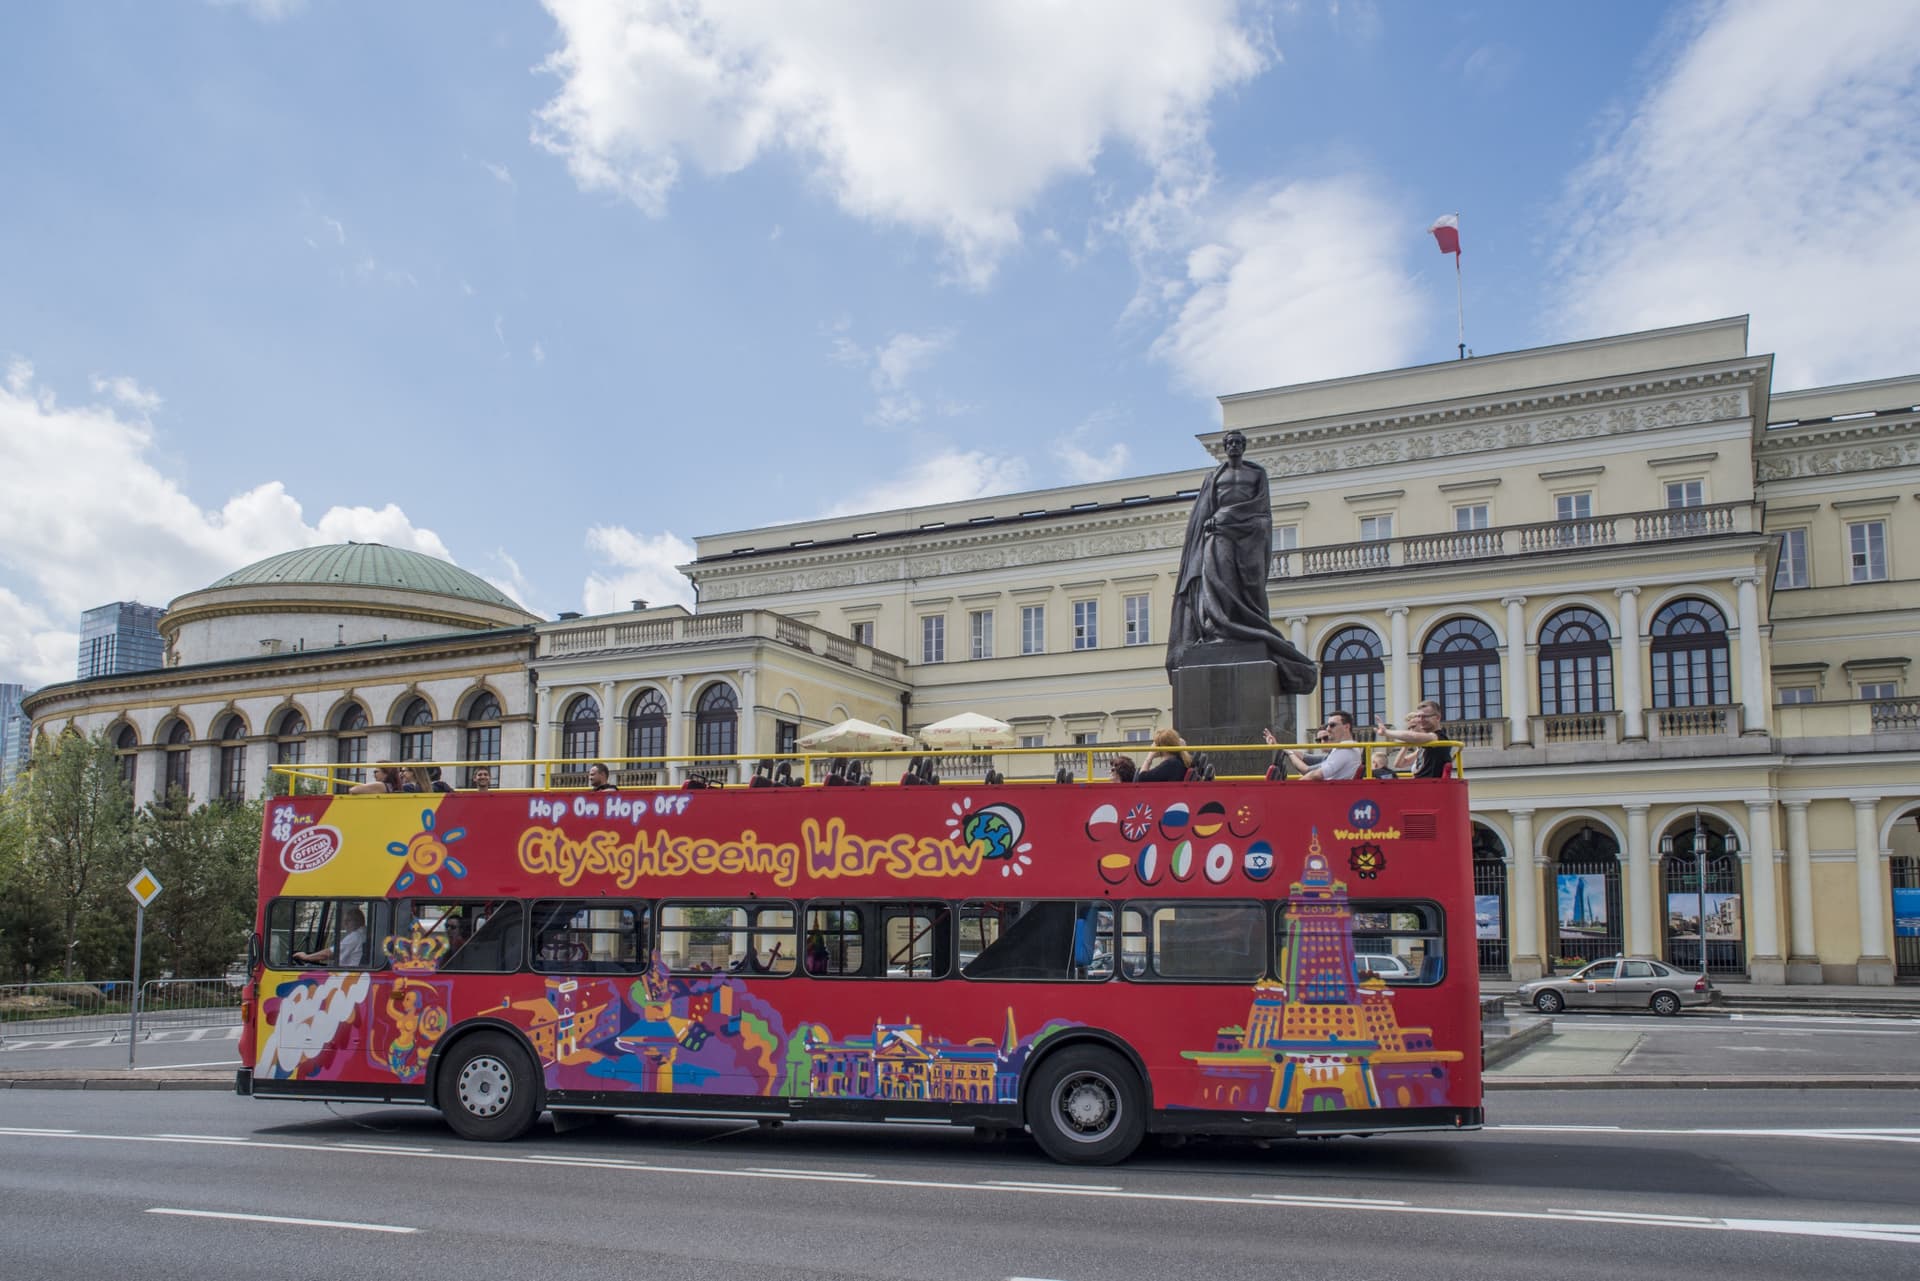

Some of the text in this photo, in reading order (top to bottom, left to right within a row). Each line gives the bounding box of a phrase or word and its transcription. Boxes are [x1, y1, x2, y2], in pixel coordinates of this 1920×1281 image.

[273, 805, 295, 824] 24
[529, 799, 566, 823] Hop
[573, 796, 600, 817] On
[605, 797, 647, 823] Hop
[271, 822, 292, 842] 48
[1333, 826, 1401, 840] Worldwide
[294, 838, 330, 860] OFFICIAL
[801, 816, 985, 879] Warsaw
